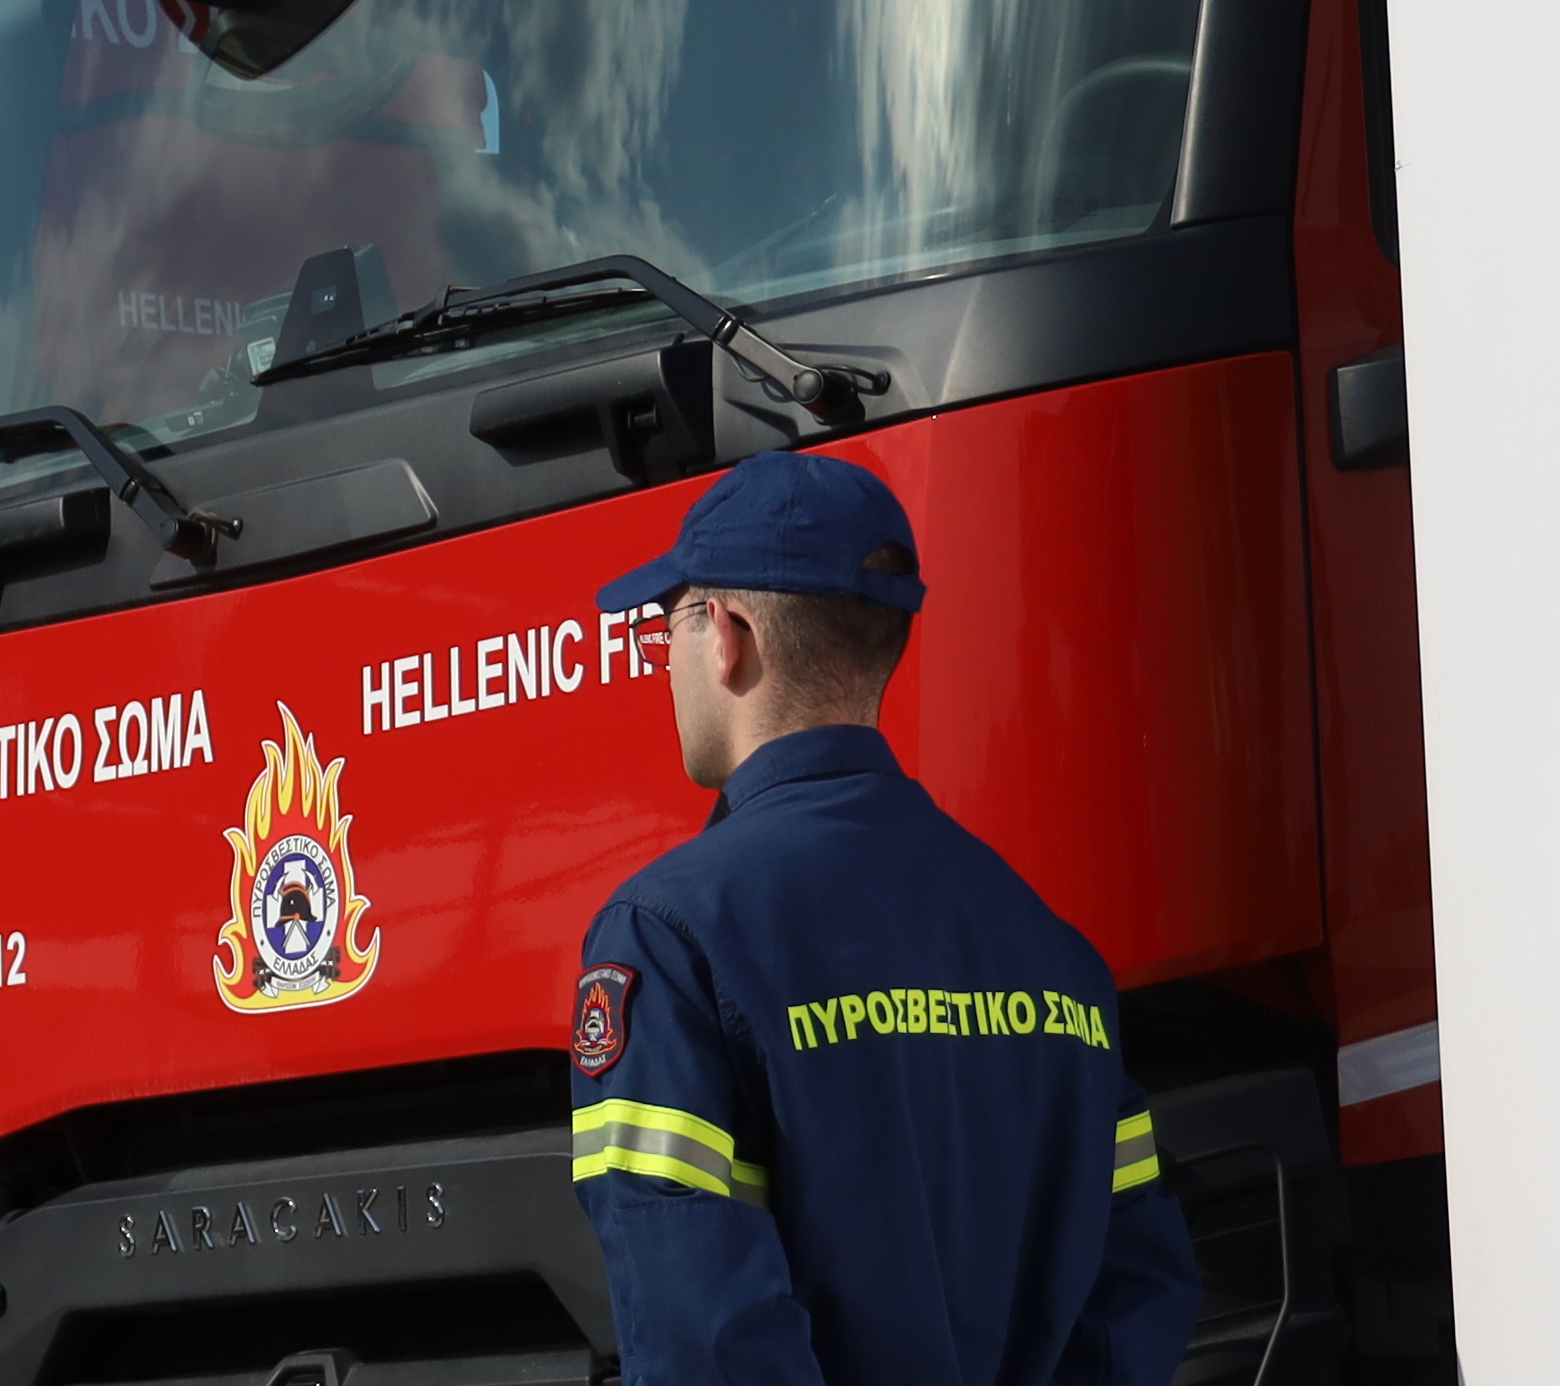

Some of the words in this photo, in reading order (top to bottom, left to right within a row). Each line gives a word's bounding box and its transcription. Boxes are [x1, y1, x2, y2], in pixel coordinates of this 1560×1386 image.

[360, 618, 585, 736] HELLENIC
[92, 688, 214, 784] ΣΩΜΑ
[253, 836, 320, 918] ΠΥΡΟΣΒΕΣΤΙΚΟ
[317, 856, 337, 909] ΣΩΜΑ
[273, 950, 319, 976] ΕΛΛΑΔΑΣ
[787, 988, 1036, 1051] ΠΥΡΟΣΒΕΣΤΙΚΟ
[117, 1181, 446, 1258] SARACAKIS
